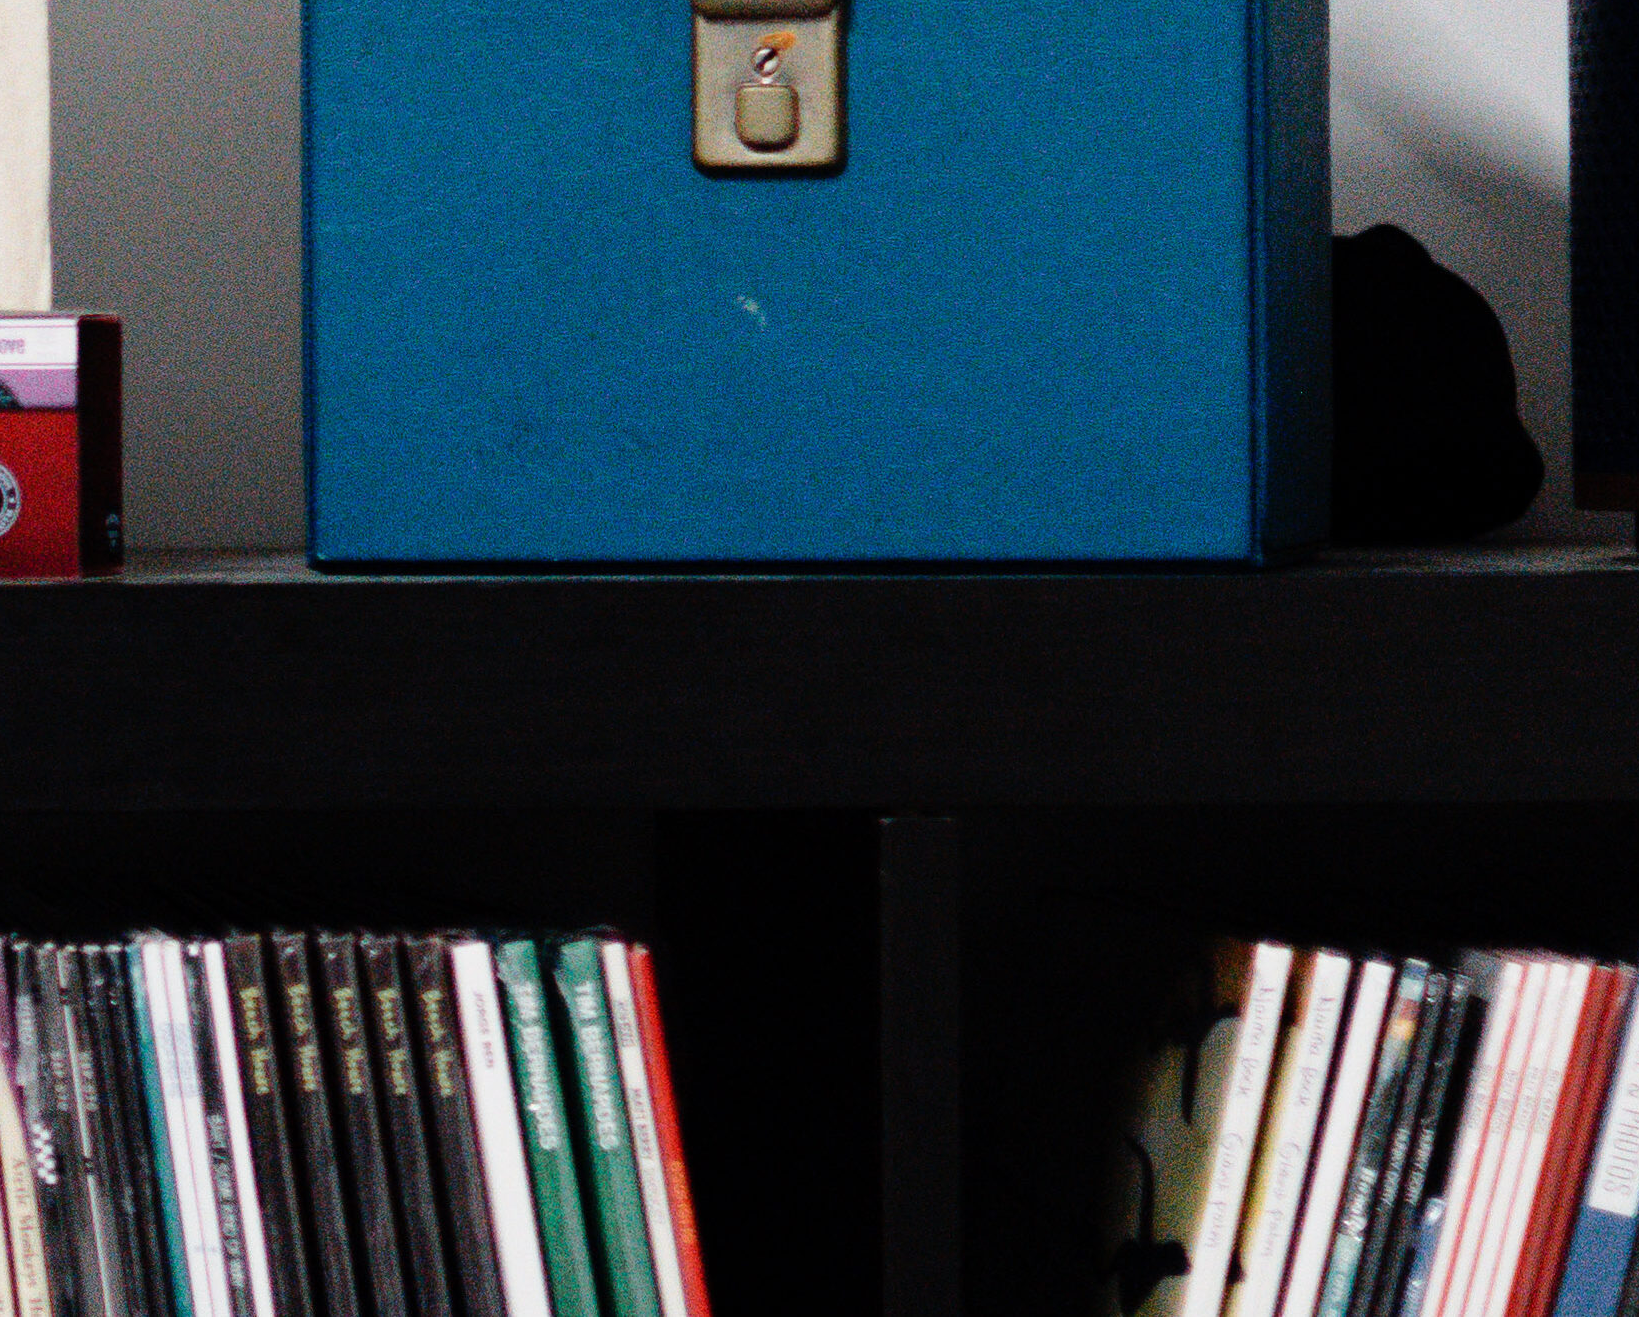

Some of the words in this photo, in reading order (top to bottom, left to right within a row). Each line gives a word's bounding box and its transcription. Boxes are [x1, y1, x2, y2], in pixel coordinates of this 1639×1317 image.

[575, 981, 597, 1019] TIM
[481, 1042, 496, 1069] BEN
[581, 1026, 620, 1150] BERNARDES
